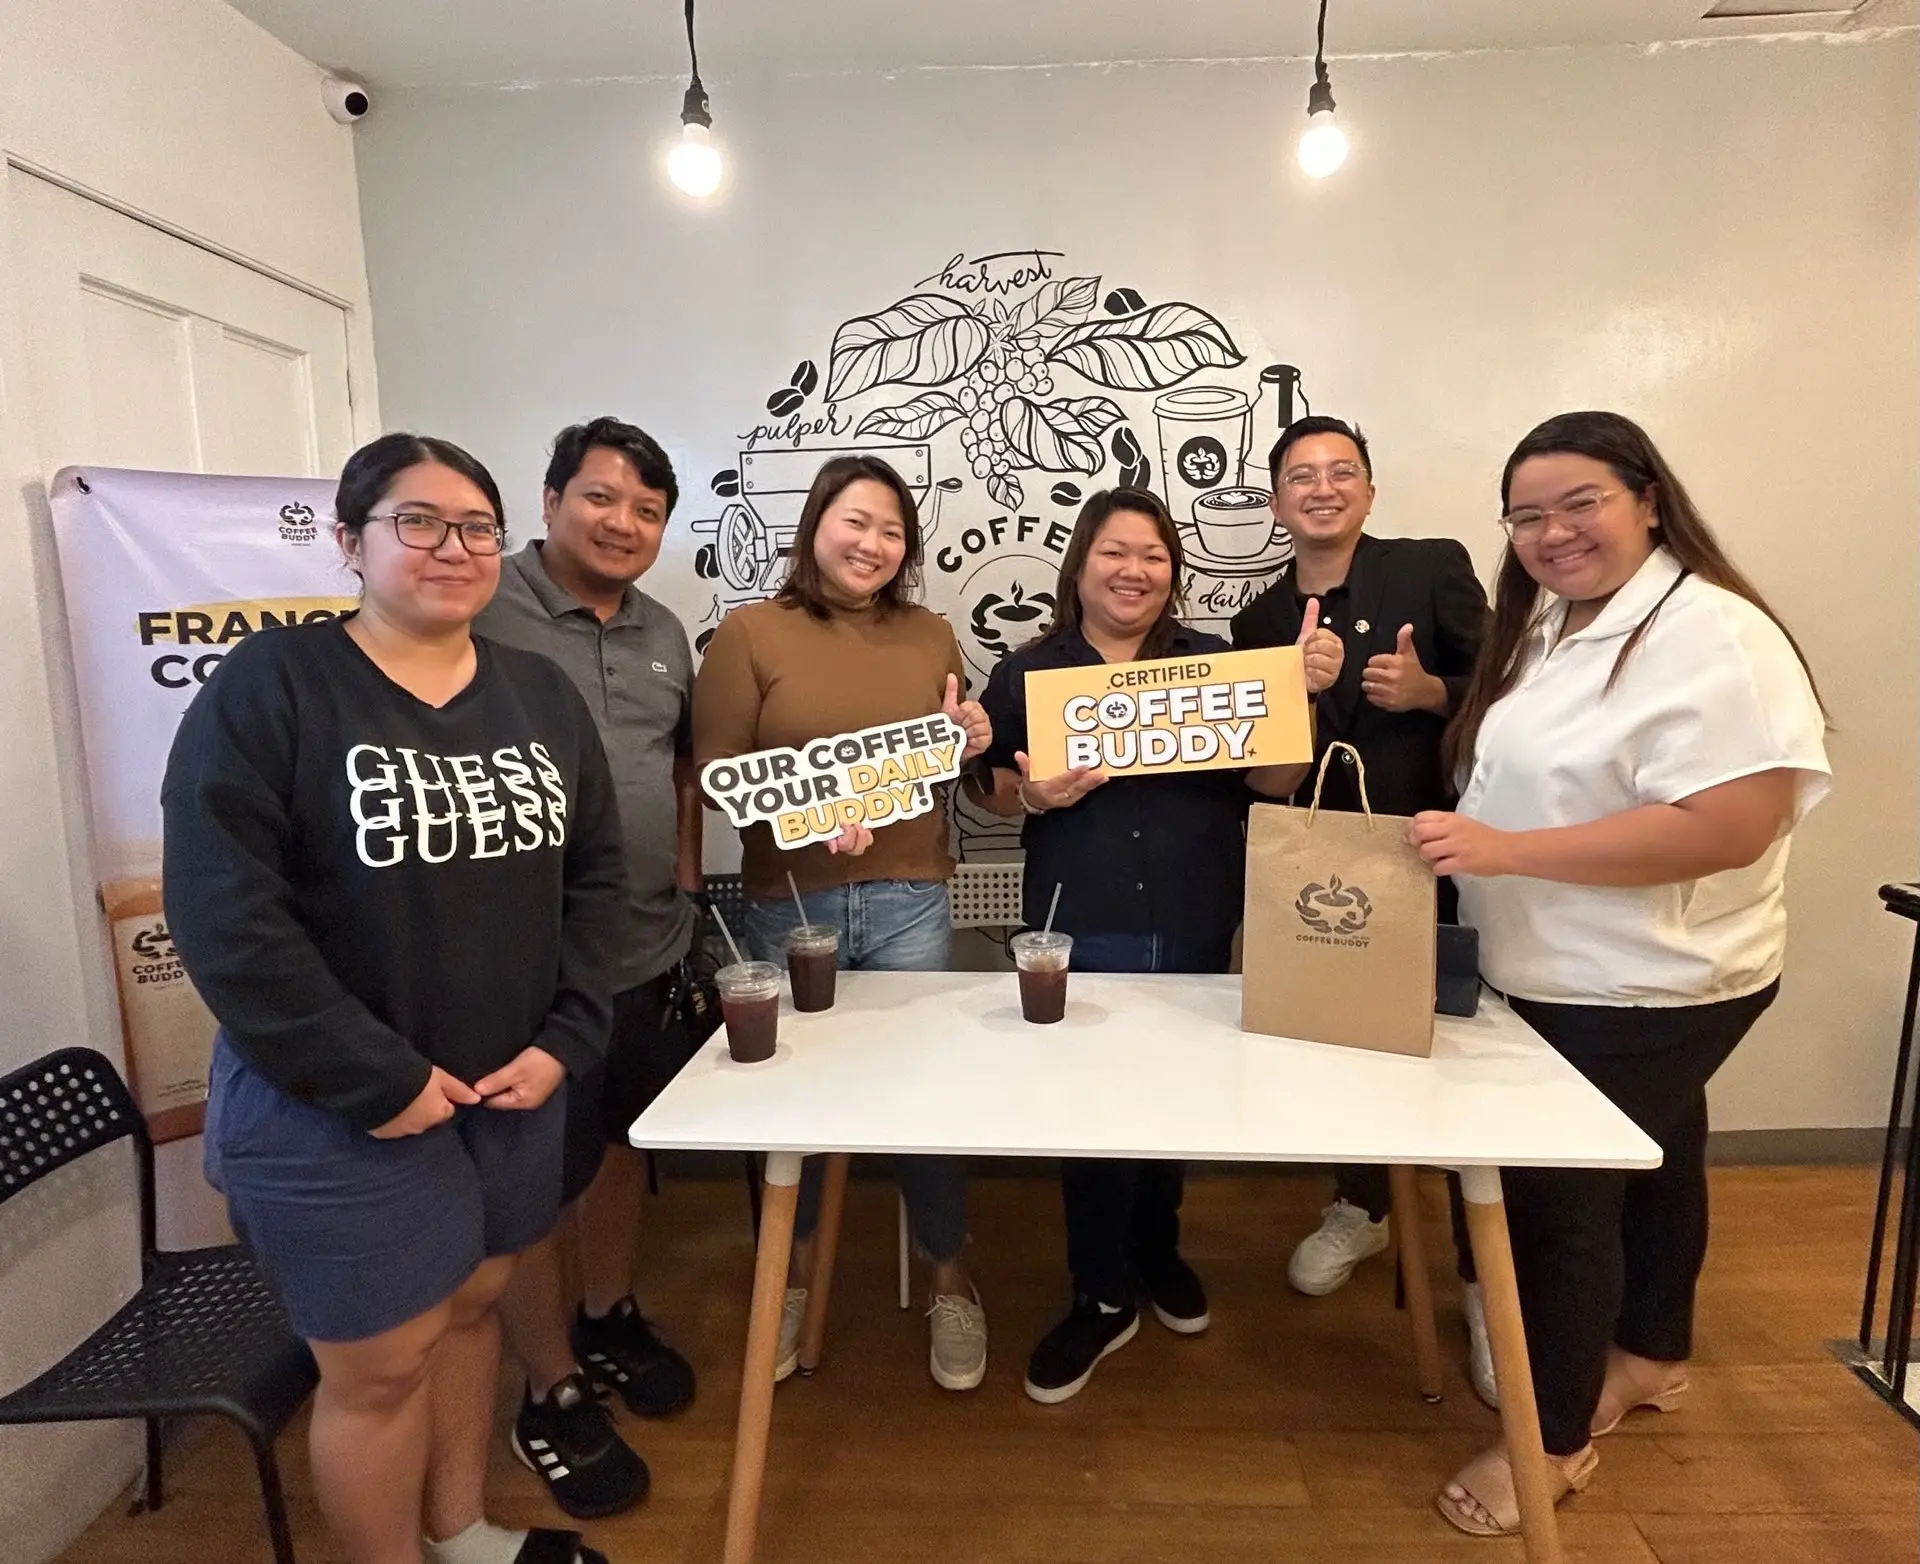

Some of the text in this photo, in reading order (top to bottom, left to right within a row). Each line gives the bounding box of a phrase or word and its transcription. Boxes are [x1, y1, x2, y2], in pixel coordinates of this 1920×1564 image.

[914, 249, 1065, 295] harvest
[737, 403, 853, 450] pulper
[281, 533, 316, 541] BUDDY
[1110, 662, 1212, 689] CERTIFIED
[1063, 679, 1268, 733] COFFEE
[346, 741, 563, 794] GUESS
[709, 718, 961, 792] OUR COFFEE,
[1065, 720, 1254, 771] BUDDY
[350, 767, 567, 832] GUESS
[724, 744, 956, 820] YOUR DAILY
[356, 797, 566, 868] GUESS
[777, 781, 929, 843] BUDDY!
[1296, 934, 1370, 949] COFFEE BUDDY
